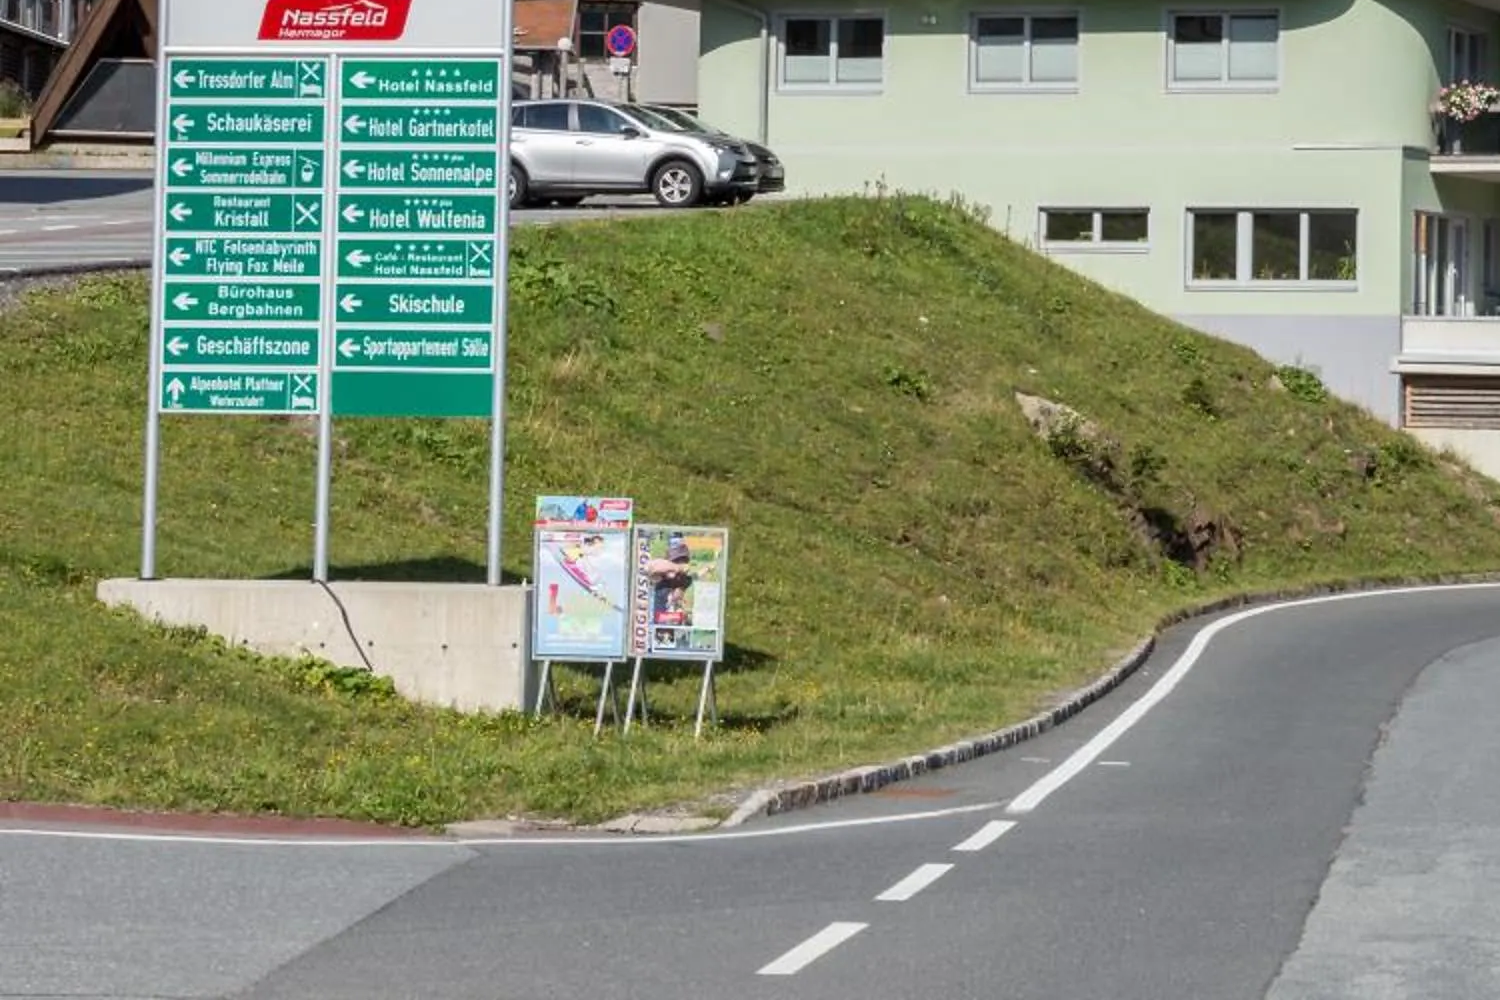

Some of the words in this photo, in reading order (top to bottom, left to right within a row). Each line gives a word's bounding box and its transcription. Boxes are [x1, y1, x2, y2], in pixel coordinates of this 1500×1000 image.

[281, 7, 388, 26] Nassfeld
[278, 27, 346, 39] Hermagor
[197, 69, 267, 89] Tressdorfer
[270, 69, 294, 89] Alm
[378, 79, 419, 93] Hotel
[424, 79, 494, 93] Nassfeld
[207, 111, 313, 133] Schaukäserei
[369, 117, 403, 137] Hotel
[409, 117, 494, 138] Gartnerkofel
[367, 162, 405, 182] Hotel
[411, 162, 493, 187] Sonnenalpe
[214, 210, 269, 227] Kristall
[369, 208, 411, 229] Hotel
[417, 208, 486, 229] Wulfenia
[223, 239, 317, 258] Felsenlabyrinth
[206, 258, 243, 275] Flying
[247, 258, 269, 273] Fox
[374, 264, 406, 275] Hotel
[409, 264, 463, 275] Nassfeld
[218, 285, 294, 299] Bürohaus
[208, 302, 303, 318] Bergbahnen
[389, 293, 465, 313] Skischule
[197, 335, 310, 355] Geschäftszone
